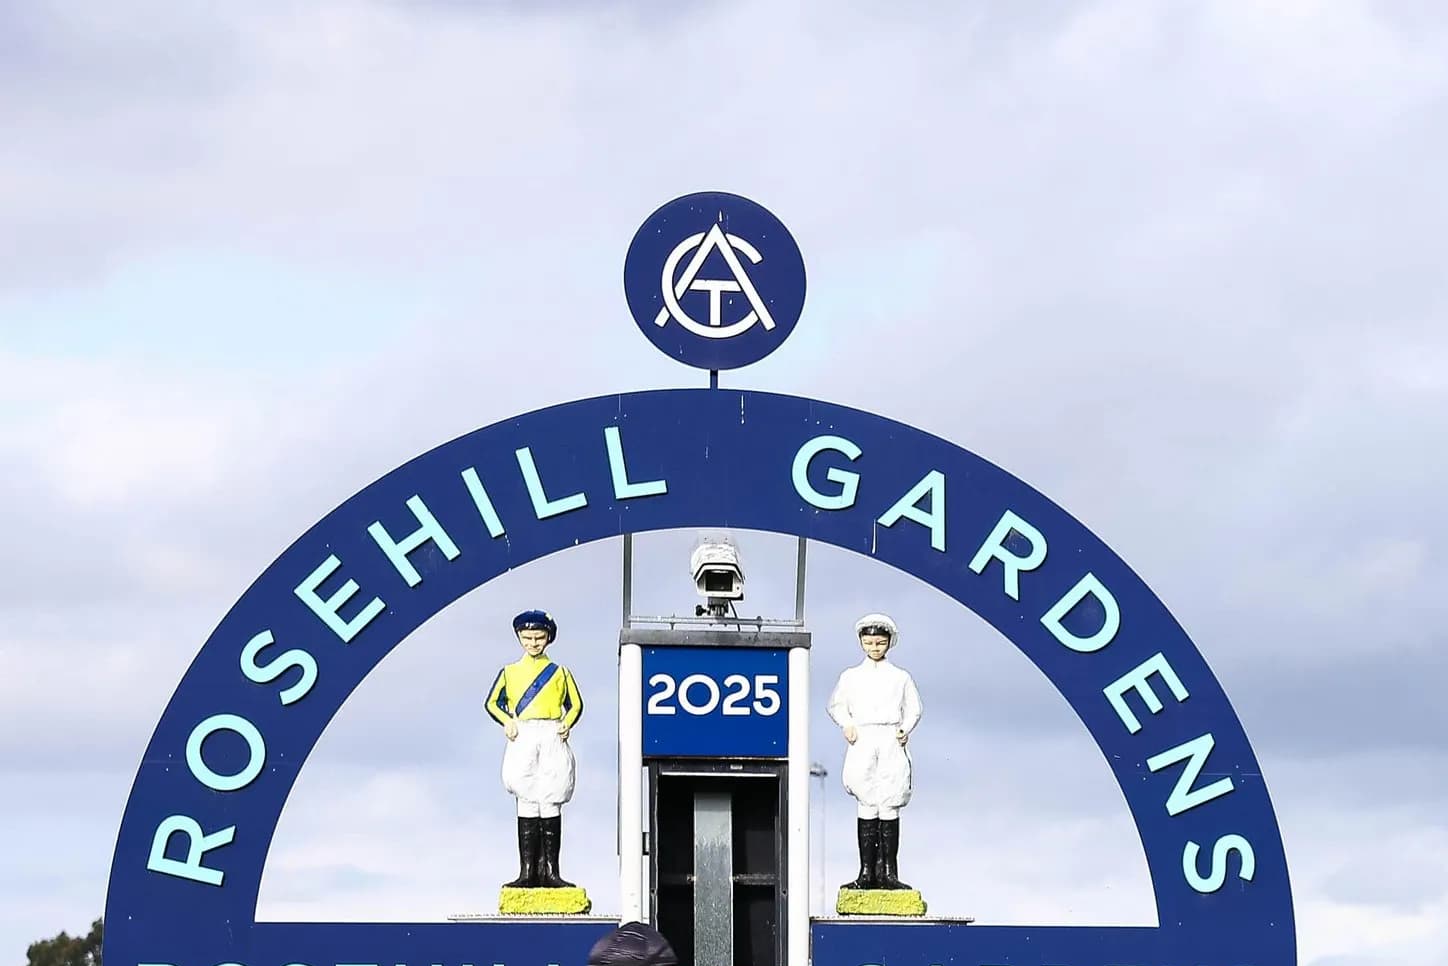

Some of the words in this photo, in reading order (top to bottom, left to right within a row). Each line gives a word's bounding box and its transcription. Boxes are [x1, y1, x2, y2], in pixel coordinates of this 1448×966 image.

[148, 427, 667, 886] ROSEHILL
[792, 434, 1256, 895] GARDENS
[647, 673, 781, 716] 2025
